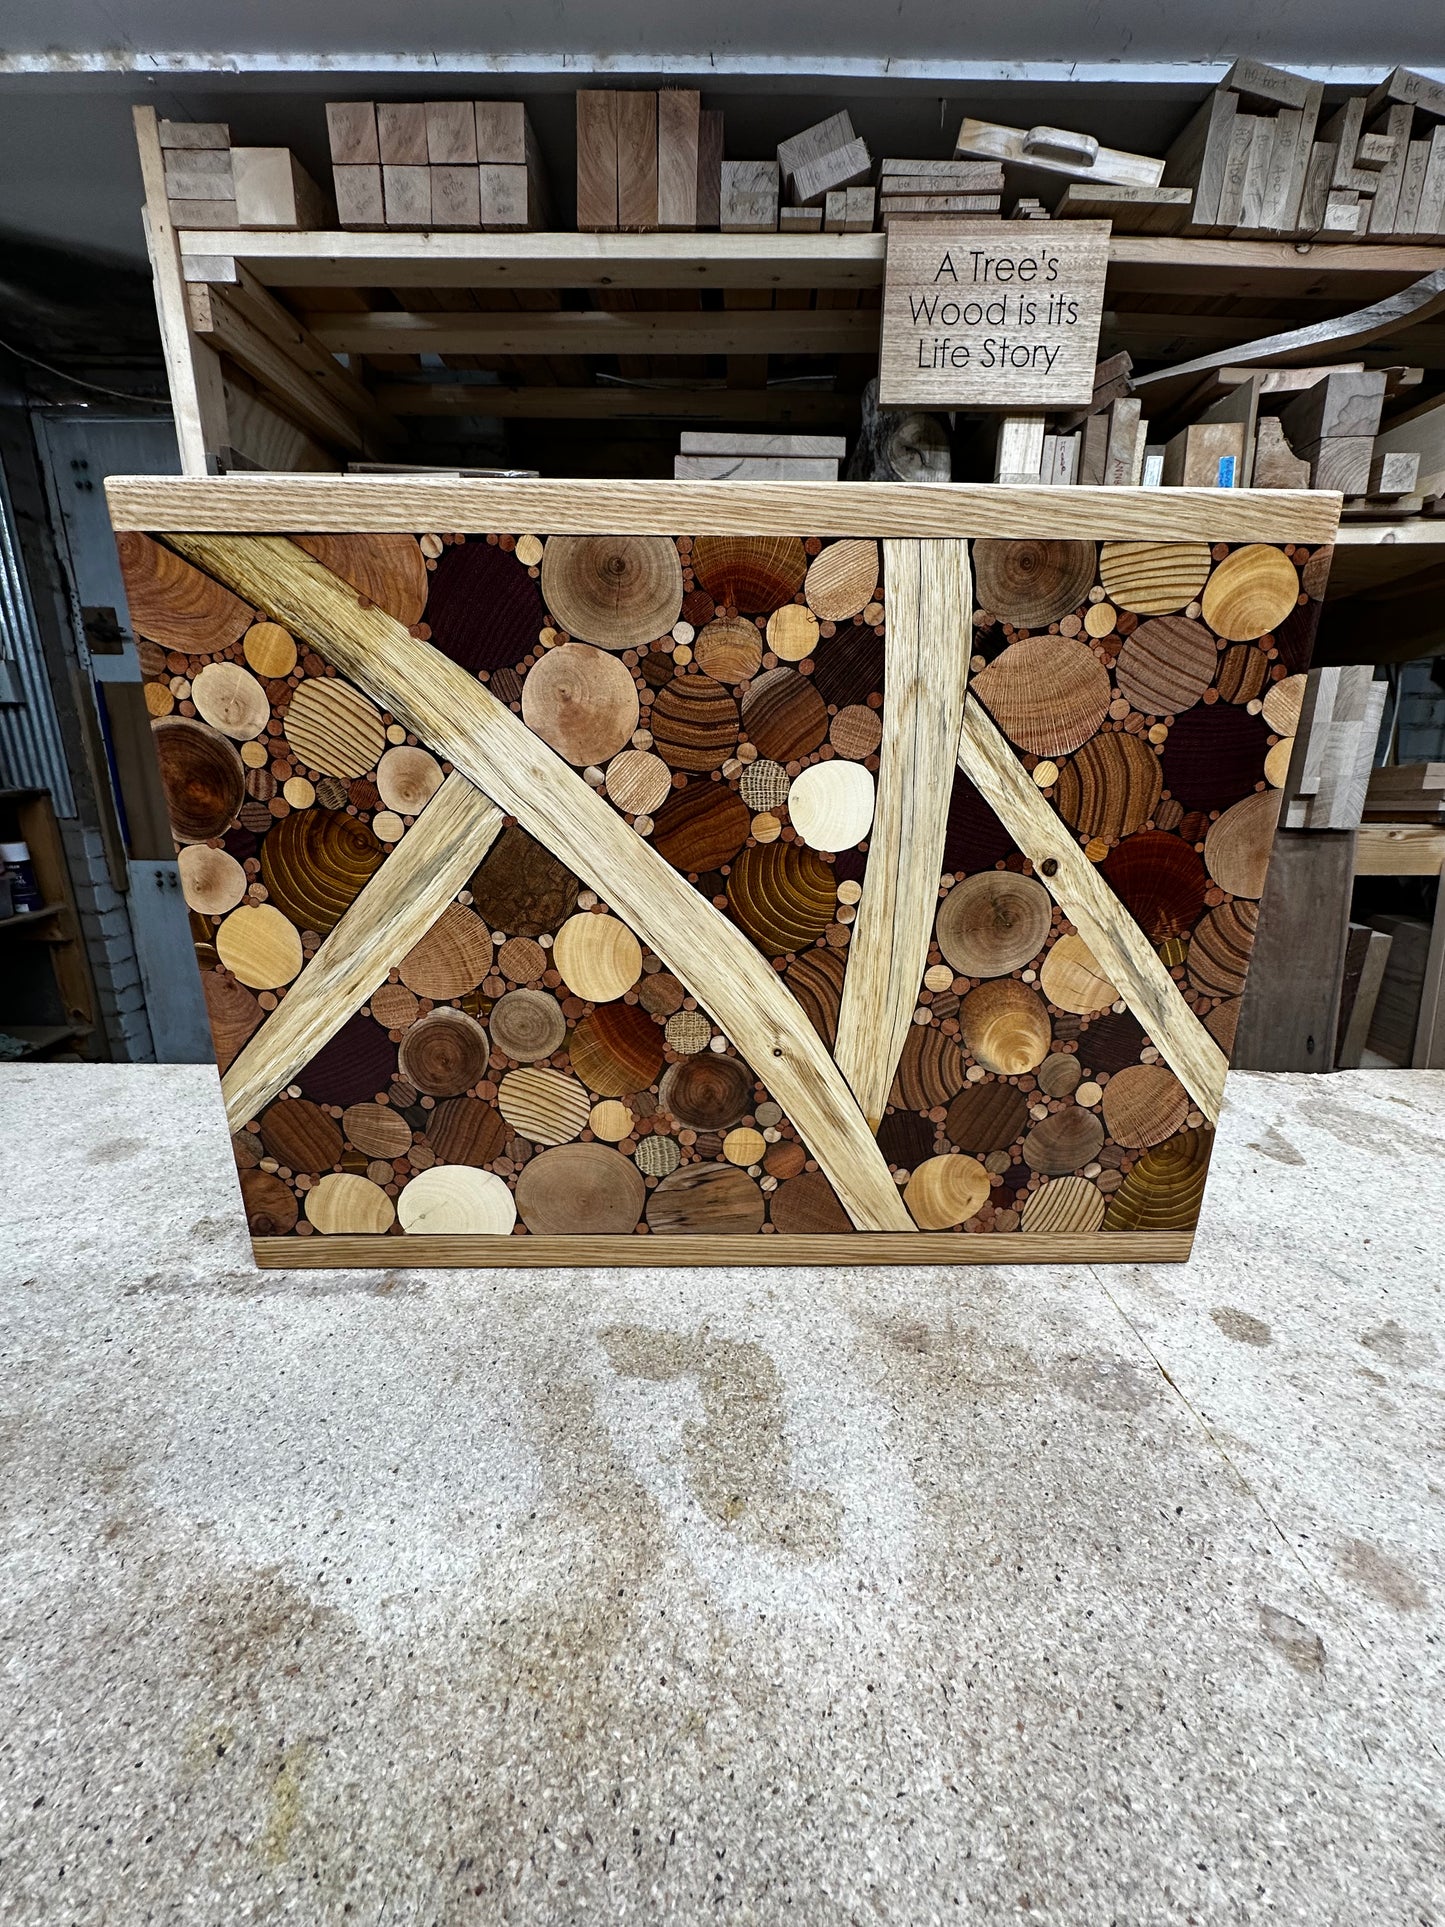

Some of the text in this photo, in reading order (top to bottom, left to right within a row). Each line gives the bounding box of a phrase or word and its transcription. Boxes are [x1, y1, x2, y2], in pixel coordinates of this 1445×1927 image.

[934, 249, 1059, 282] A Tree's
[909, 293, 1079, 325] Wood is its
[918, 338, 1061, 375] Life Story
